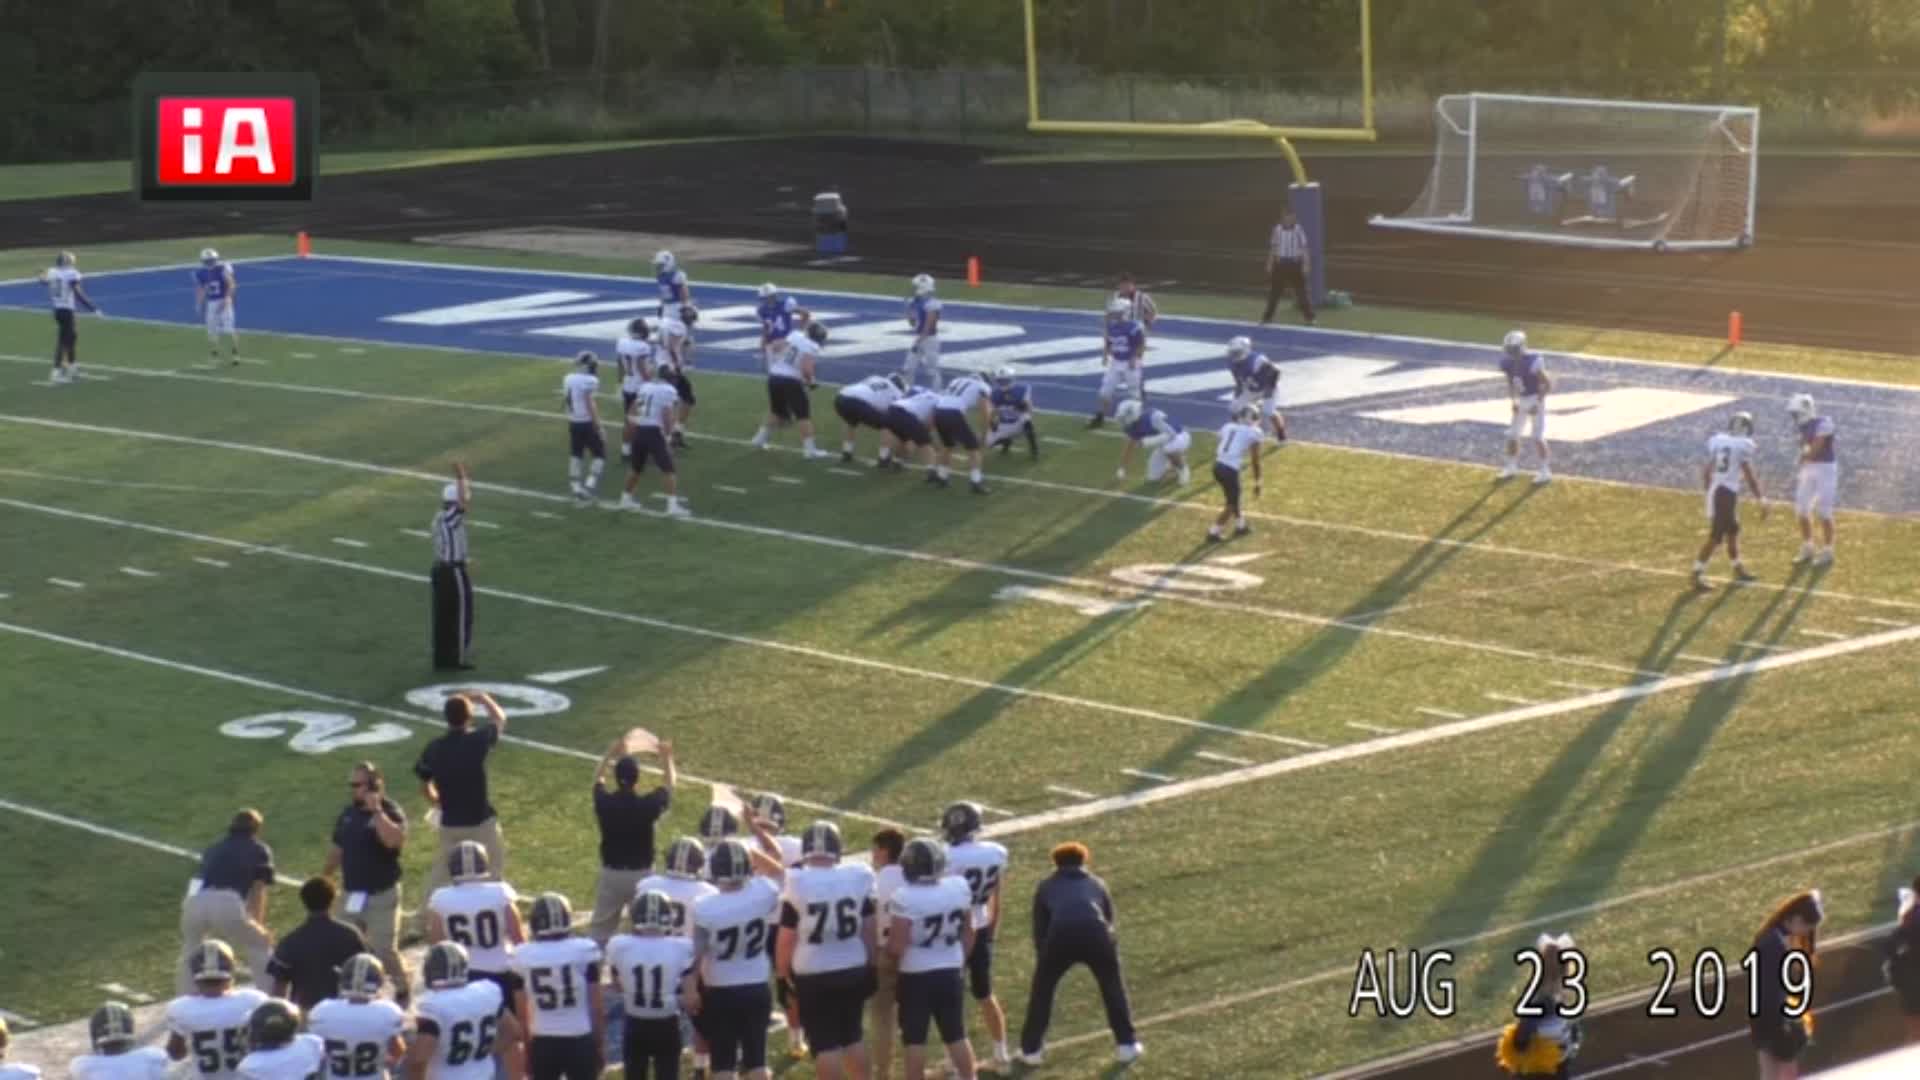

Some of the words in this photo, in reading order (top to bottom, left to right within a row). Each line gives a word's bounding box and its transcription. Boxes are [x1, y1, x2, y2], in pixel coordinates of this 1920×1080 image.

[382, 291, 1738, 442] VERONA
[1714, 446, 1732, 473] 3
[219, 681, 572, 754] 20
[447, 910, 499, 949] 60
[716, 917, 766, 961] 72
[807, 896, 857, 945] 76
[918, 908, 965, 948] 73
[530, 963, 577, 1010] 51
[631, 963, 665, 1009] 11
[324, 1038, 380, 1078] 52
